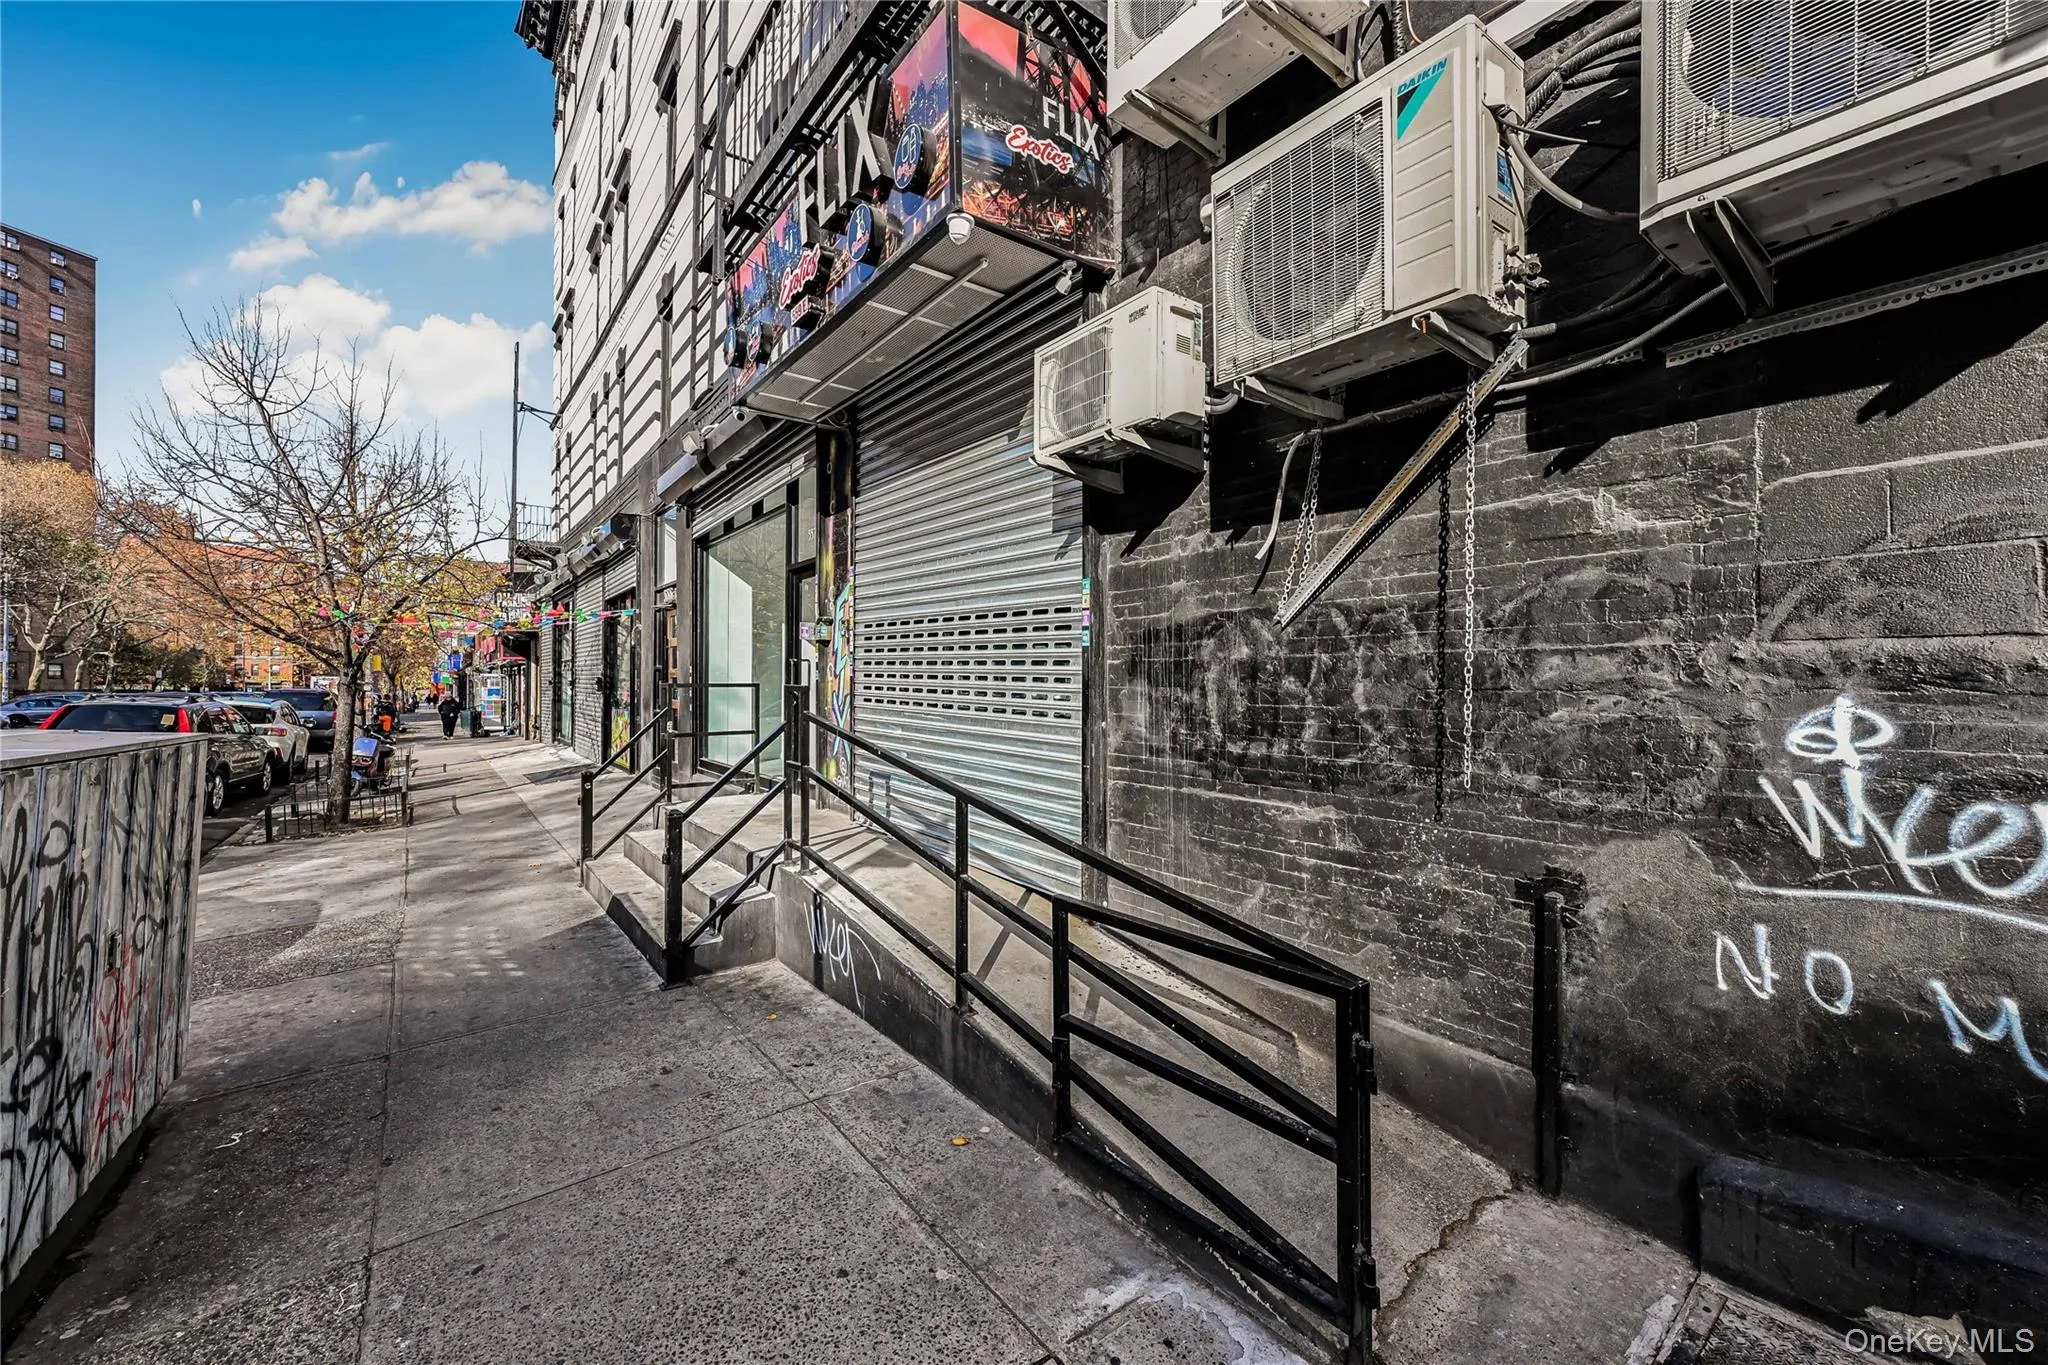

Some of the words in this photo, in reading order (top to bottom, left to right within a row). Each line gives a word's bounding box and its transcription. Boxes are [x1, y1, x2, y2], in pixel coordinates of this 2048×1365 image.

[1397, 57, 1448, 95] DAIKIN
[799, 73, 882, 247] FLIX
[1006, 125, 1074, 174] Exotics
[1043, 96, 1100, 161] FLIX
[779, 243, 820, 308] Exotics
